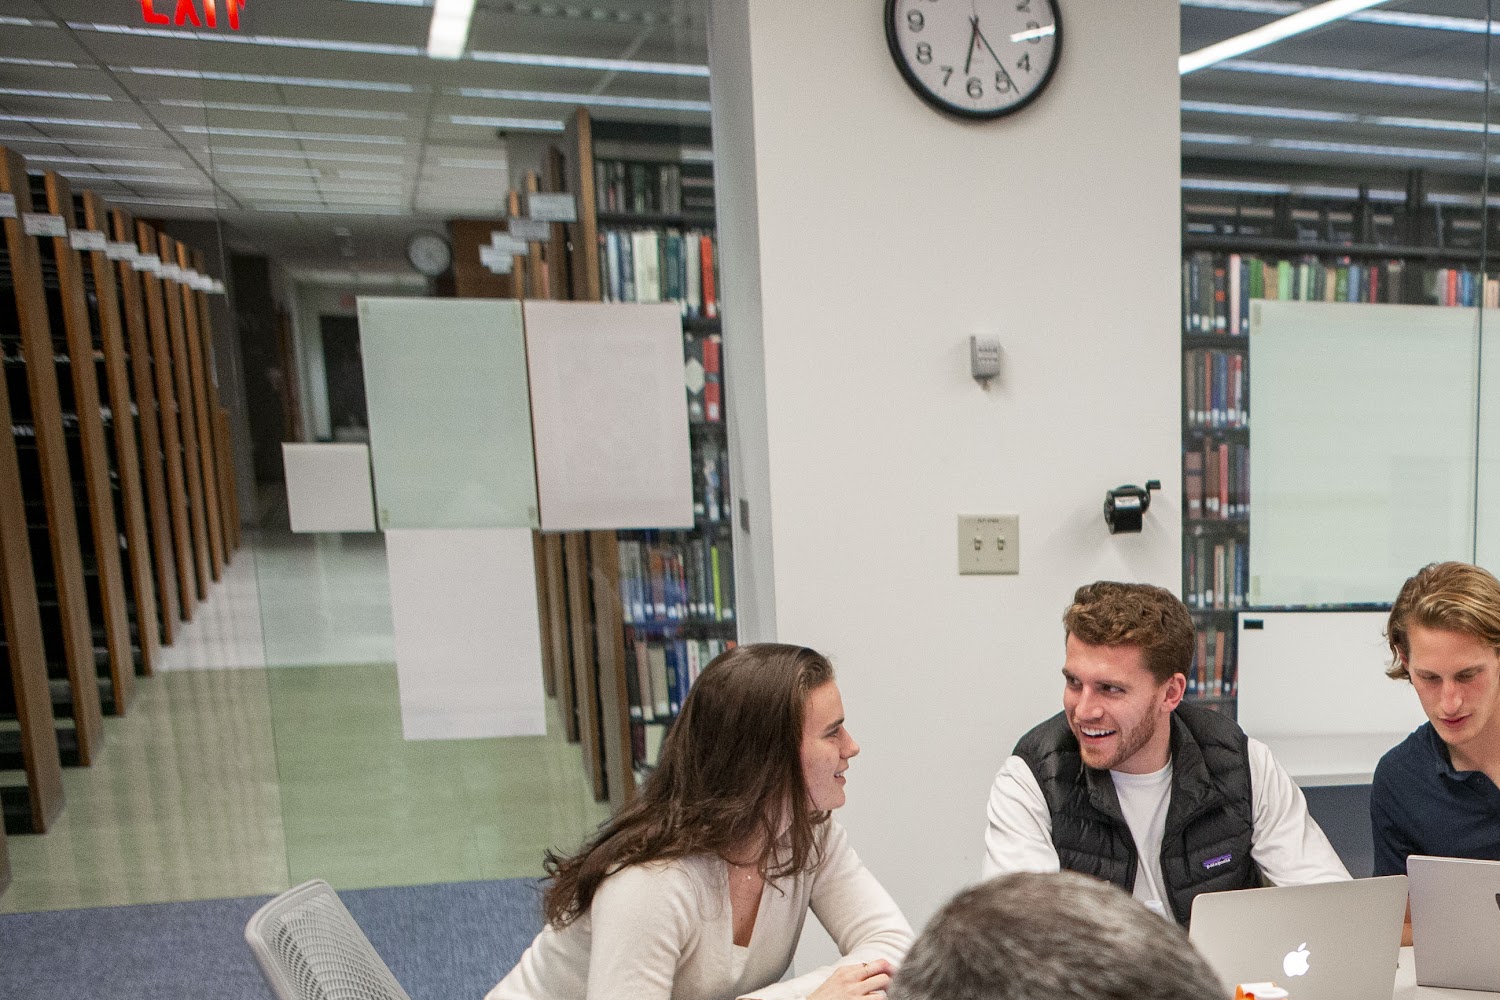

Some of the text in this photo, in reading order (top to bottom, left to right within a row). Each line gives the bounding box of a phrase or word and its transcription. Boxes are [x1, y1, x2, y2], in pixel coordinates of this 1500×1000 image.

[906, 9, 925, 32] 9
[916, 41, 933, 65] 8
[1016, 51, 1031, 73] 4
[940, 65, 954, 87] 7
[995, 71, 1012, 94] 5
[966, 77, 983, 99] 6
